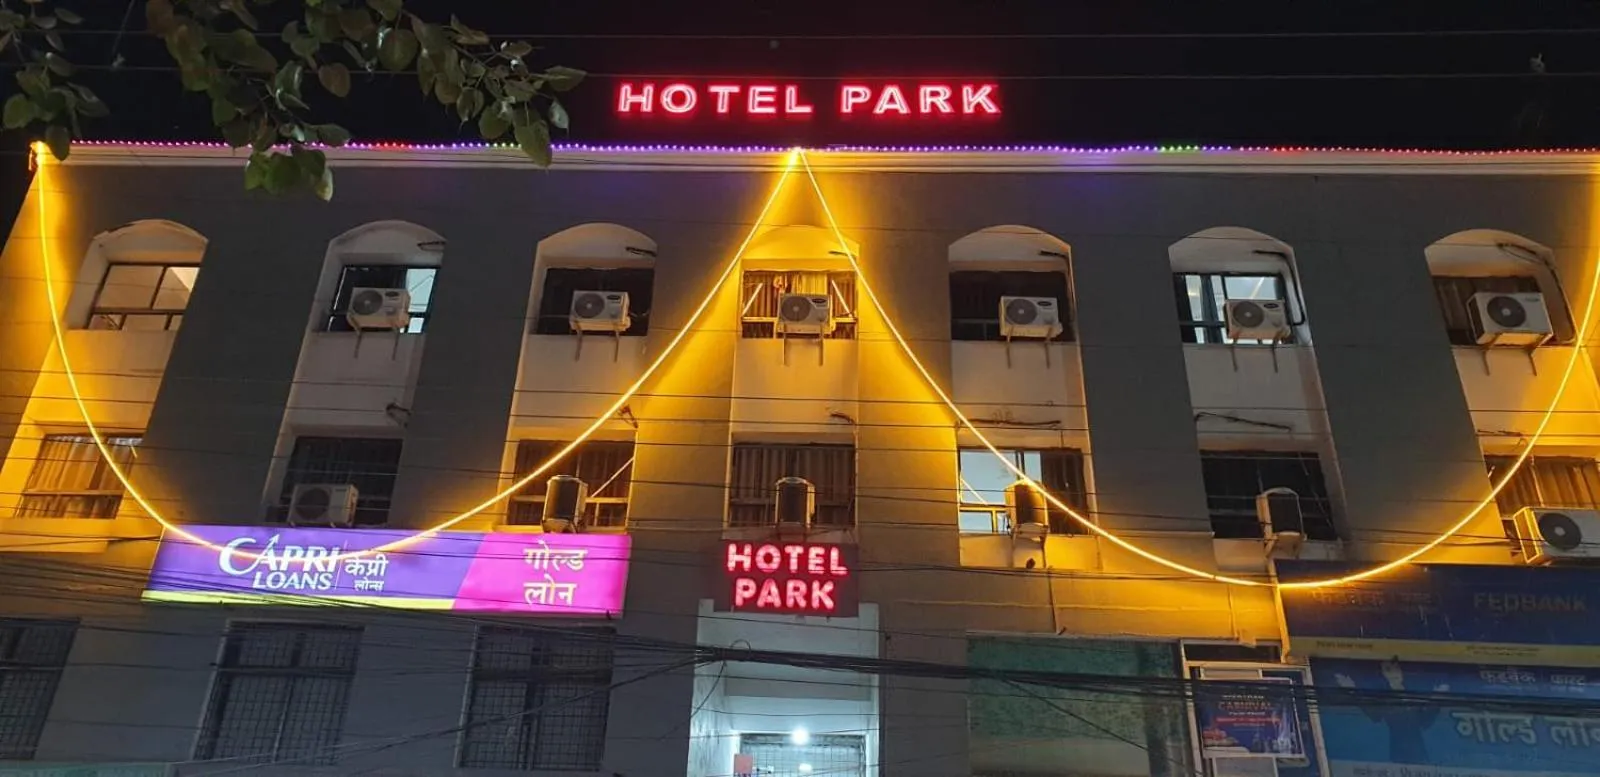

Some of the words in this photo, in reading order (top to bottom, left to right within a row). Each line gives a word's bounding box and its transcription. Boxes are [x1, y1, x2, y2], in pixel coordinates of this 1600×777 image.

[617, 84, 814, 114] HOTEL
[840, 84, 1001, 114] PARK
[219, 534, 340, 574] CAPRI
[523, 539, 588, 571] गोल्ड
[727, 543, 848, 575] HOTEL
[253, 571, 333, 590] LOANS
[523, 573, 577, 606] लोन
[734, 578, 835, 609] PARK
[1473, 591, 1588, 613] FEDBANK
